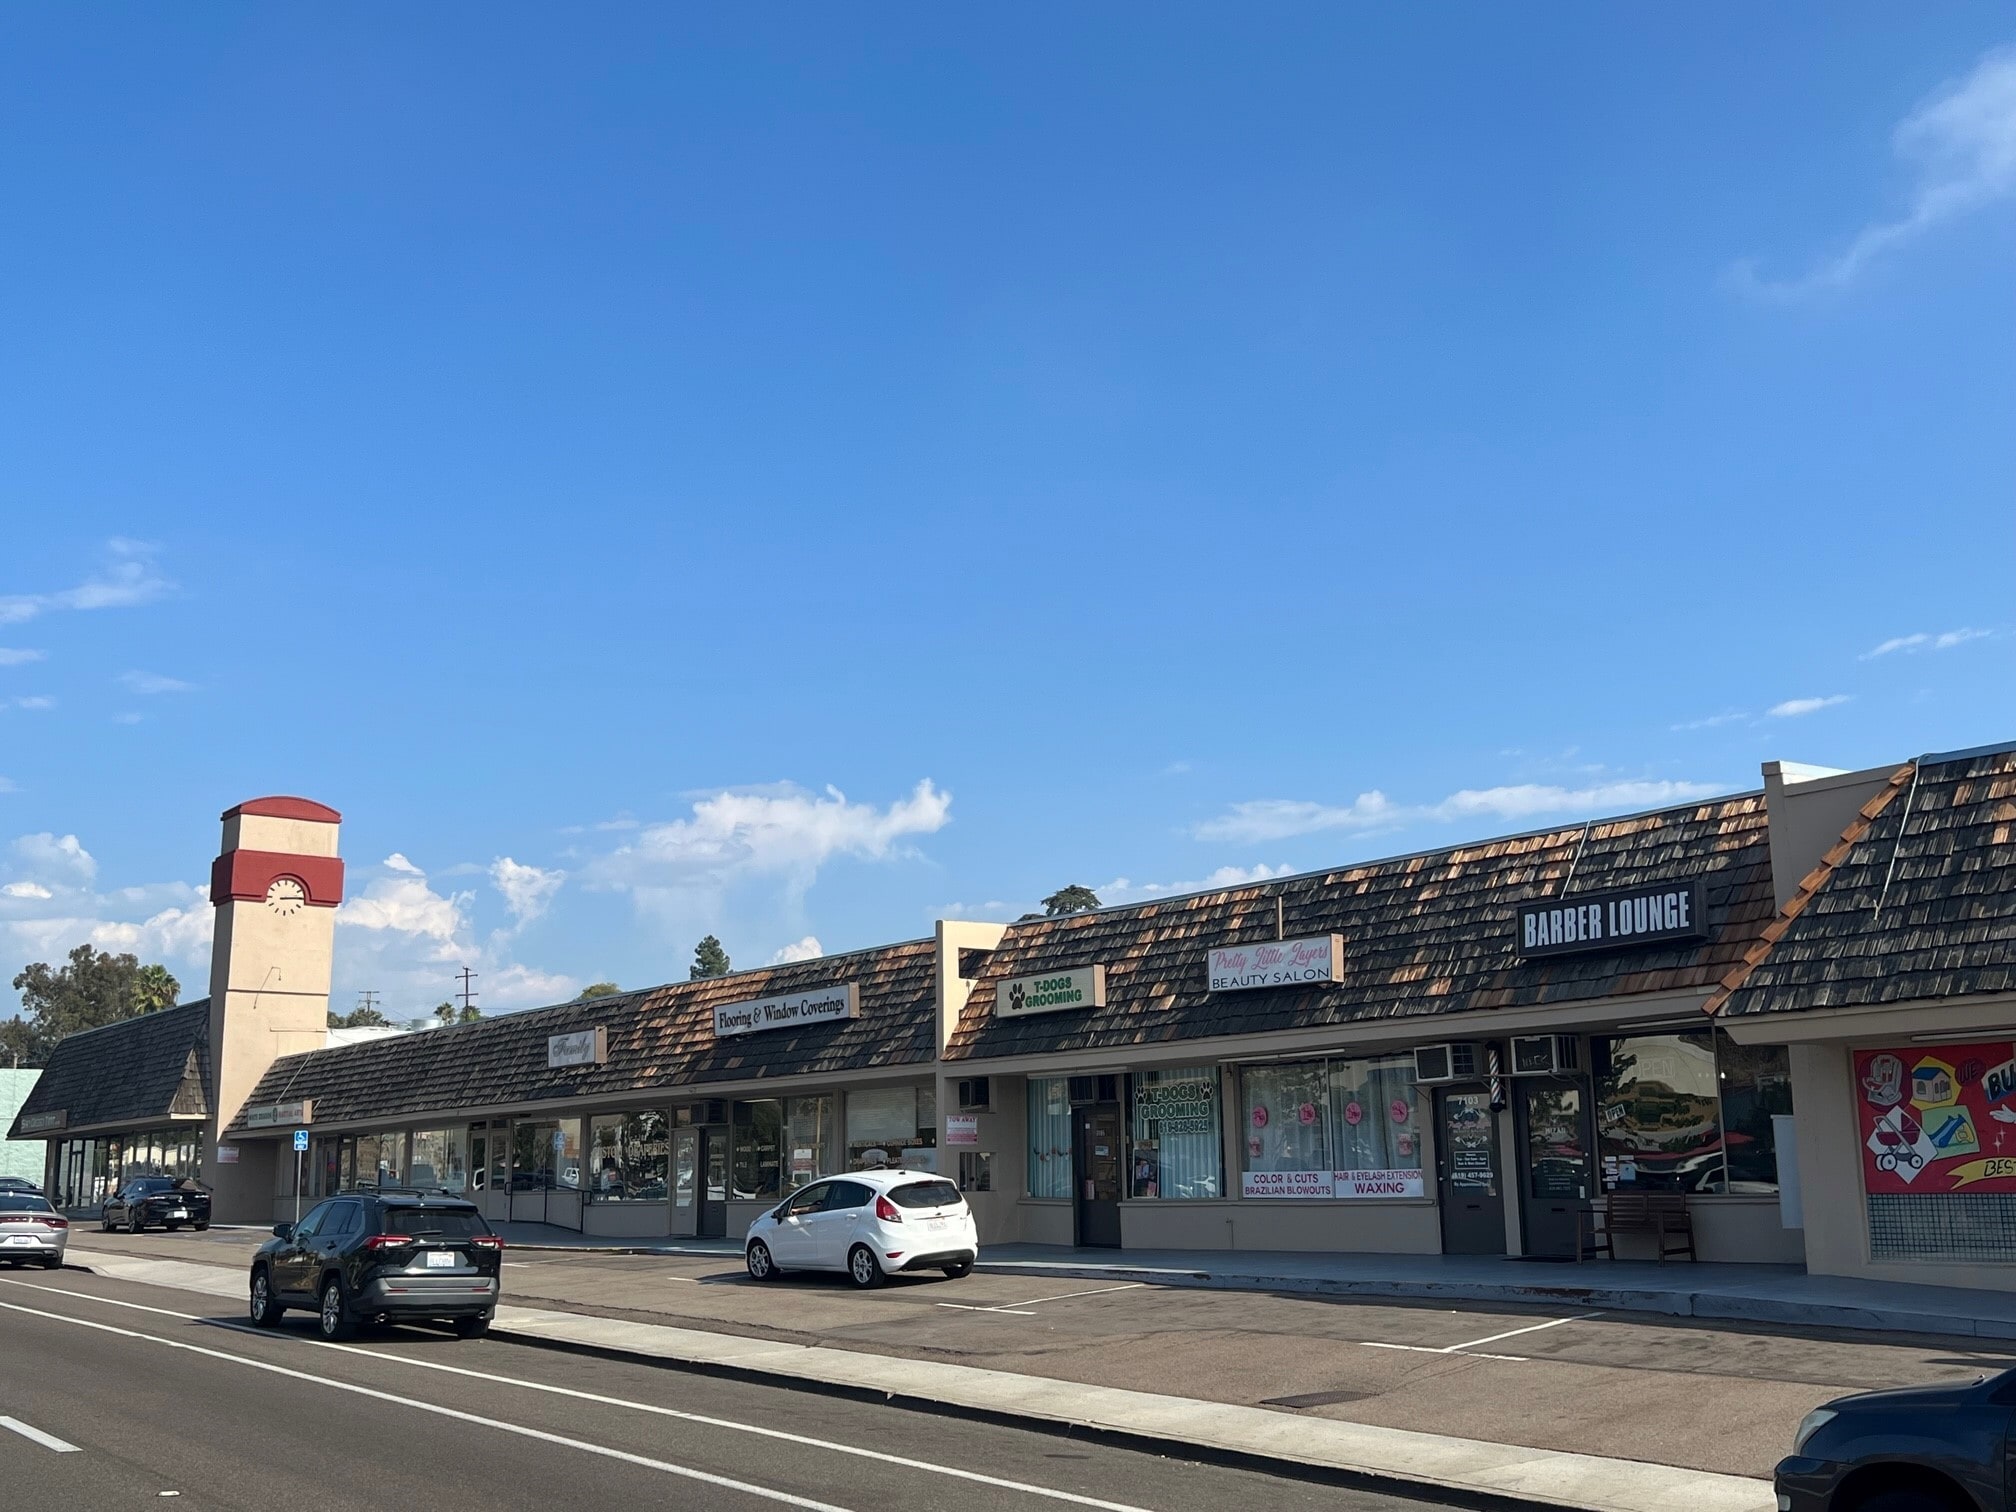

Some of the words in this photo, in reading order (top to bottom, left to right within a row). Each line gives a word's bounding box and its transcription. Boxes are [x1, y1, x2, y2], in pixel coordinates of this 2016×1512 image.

[1524, 904, 1601, 948] BARBER
[1609, 891, 1690, 937] LOUNGE
[1212, 950, 1247, 974] Pretty
[1251, 946, 1286, 970] Little
[1288, 941, 1328, 968] Layers
[1034, 976, 1072, 994] T-DOGS
[1212, 973, 1268, 989] BEAUTY
[1273, 967, 1329, 983] SALON
[1025, 989, 1083, 1008] GROOMING
[719, 1010, 752, 1029] Flooring
[753, 1007, 762, 1024] &
[764, 1001, 799, 1022] Window
[801, 996, 845, 1017] Coverings
[552, 1036, 592, 1061] Family
[1959, 1062, 1979, 1083] WE
[1150, 1083, 1197, 1102] T-DOGS
[1457, 1096, 1479, 1105] 7103
[1140, 1101, 1210, 1120] GROOMING
[1605, 1104, 1625, 1121] OPEN
[1253, 1173, 1283, 1184] COLOR
[1286, 1173, 1293, 1183] &
[1294, 1173, 1319, 1183] CUTS
[1334, 1172, 1349, 1181] HAIR
[1351, 1171, 1356, 1181] &
[1356, 1171, 1386, 1181] EYELASH
[1386, 1169, 1423, 1181] EXTENSION
[1245, 1185, 1286, 1195] BRAZILIAN
[1286, 1185, 1331, 1195] BLOWOUTS
[1354, 1182, 1405, 1195] WAXING
